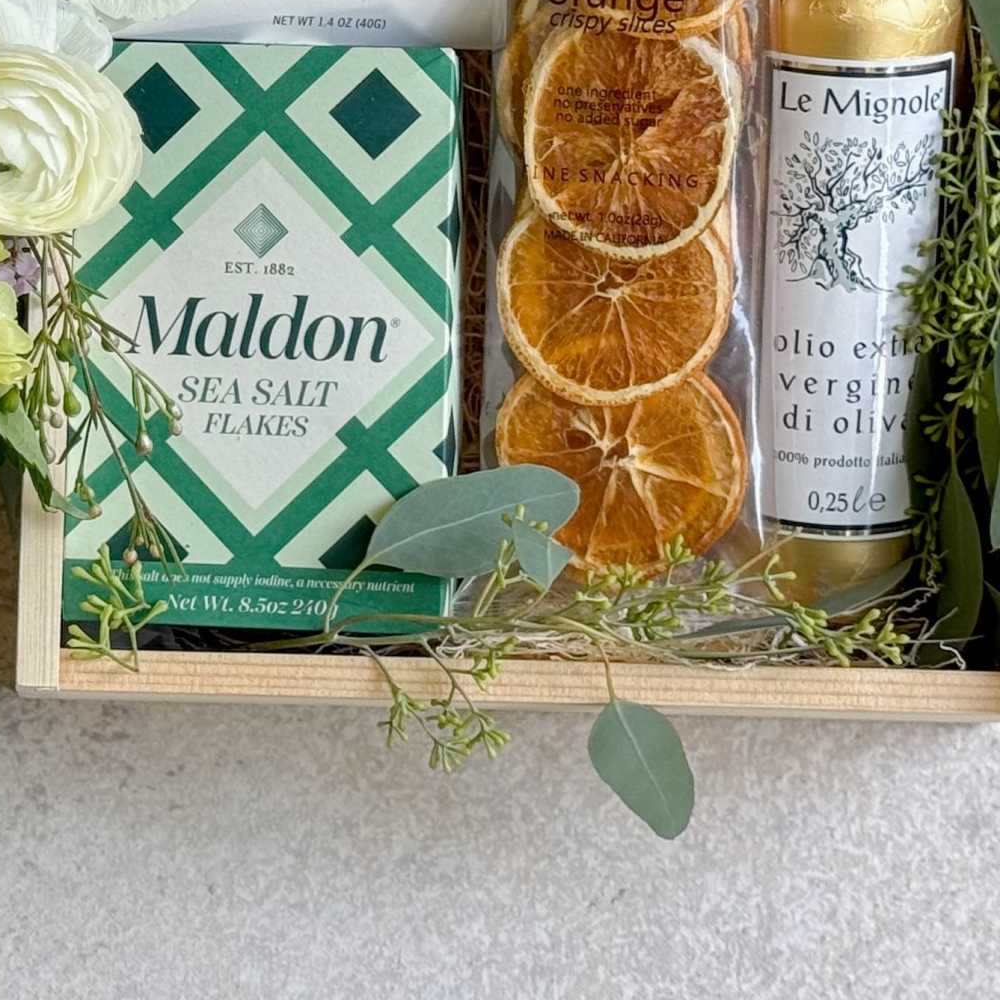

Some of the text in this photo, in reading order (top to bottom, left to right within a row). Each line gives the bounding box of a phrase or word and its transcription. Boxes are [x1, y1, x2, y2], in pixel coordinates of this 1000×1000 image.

[272, 15, 387, 30] NET WT 1.4 OZ (40G)
[550, 8, 677, 35] crispy slices
[557, 86, 583, 97] one
[780, 81, 813, 113] Le
[553, 98, 570, 110] no
[555, 112, 574, 123] no
[522, 164, 699, 189] INE SNACKING
[224, 261, 295, 276] EST. 1882
[774, 329, 835, 358] olio
[177, 376, 339, 408] SEA SALT
[203, 413, 309, 437] FLAKES
[783, 404, 813, 432] di
[777, 450, 905, 469] 00% prodotto italia
[112, 568, 138, 581] Thi
[138, 569, 160, 582] alt
[191, 573, 211, 583] not
[214, 573, 251, 589] supply
[254, 574, 294, 588] iodine,
[295, 578, 304, 588] a
[366, 580, 415, 593] nutrient
[167, 594, 197, 611] Net
[203, 595, 233, 612] Wt.
[238, 596, 289, 615] 8.5oz
